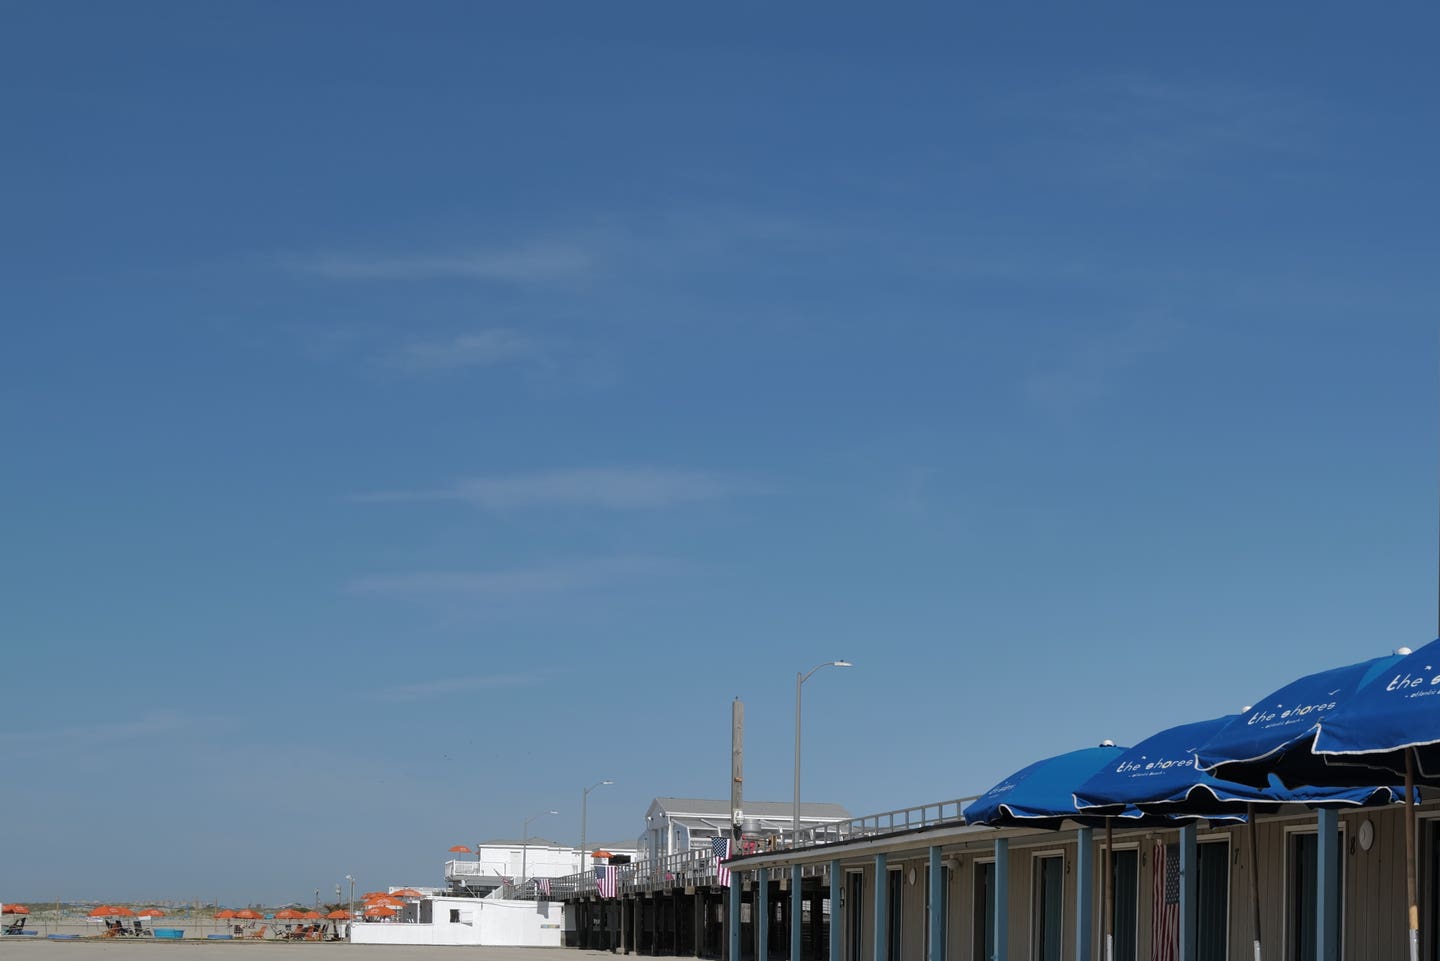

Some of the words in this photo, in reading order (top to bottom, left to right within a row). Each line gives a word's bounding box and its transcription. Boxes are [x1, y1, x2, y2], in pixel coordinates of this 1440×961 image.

[1386, 673, 1423, 691] the
[1247, 711, 1276, 725] the
[1281, 701, 1337, 718] shores
[1116, 761, 1141, 773] the
[1145, 758, 1194, 770] shores
[1350, 836, 1356, 855] 8
